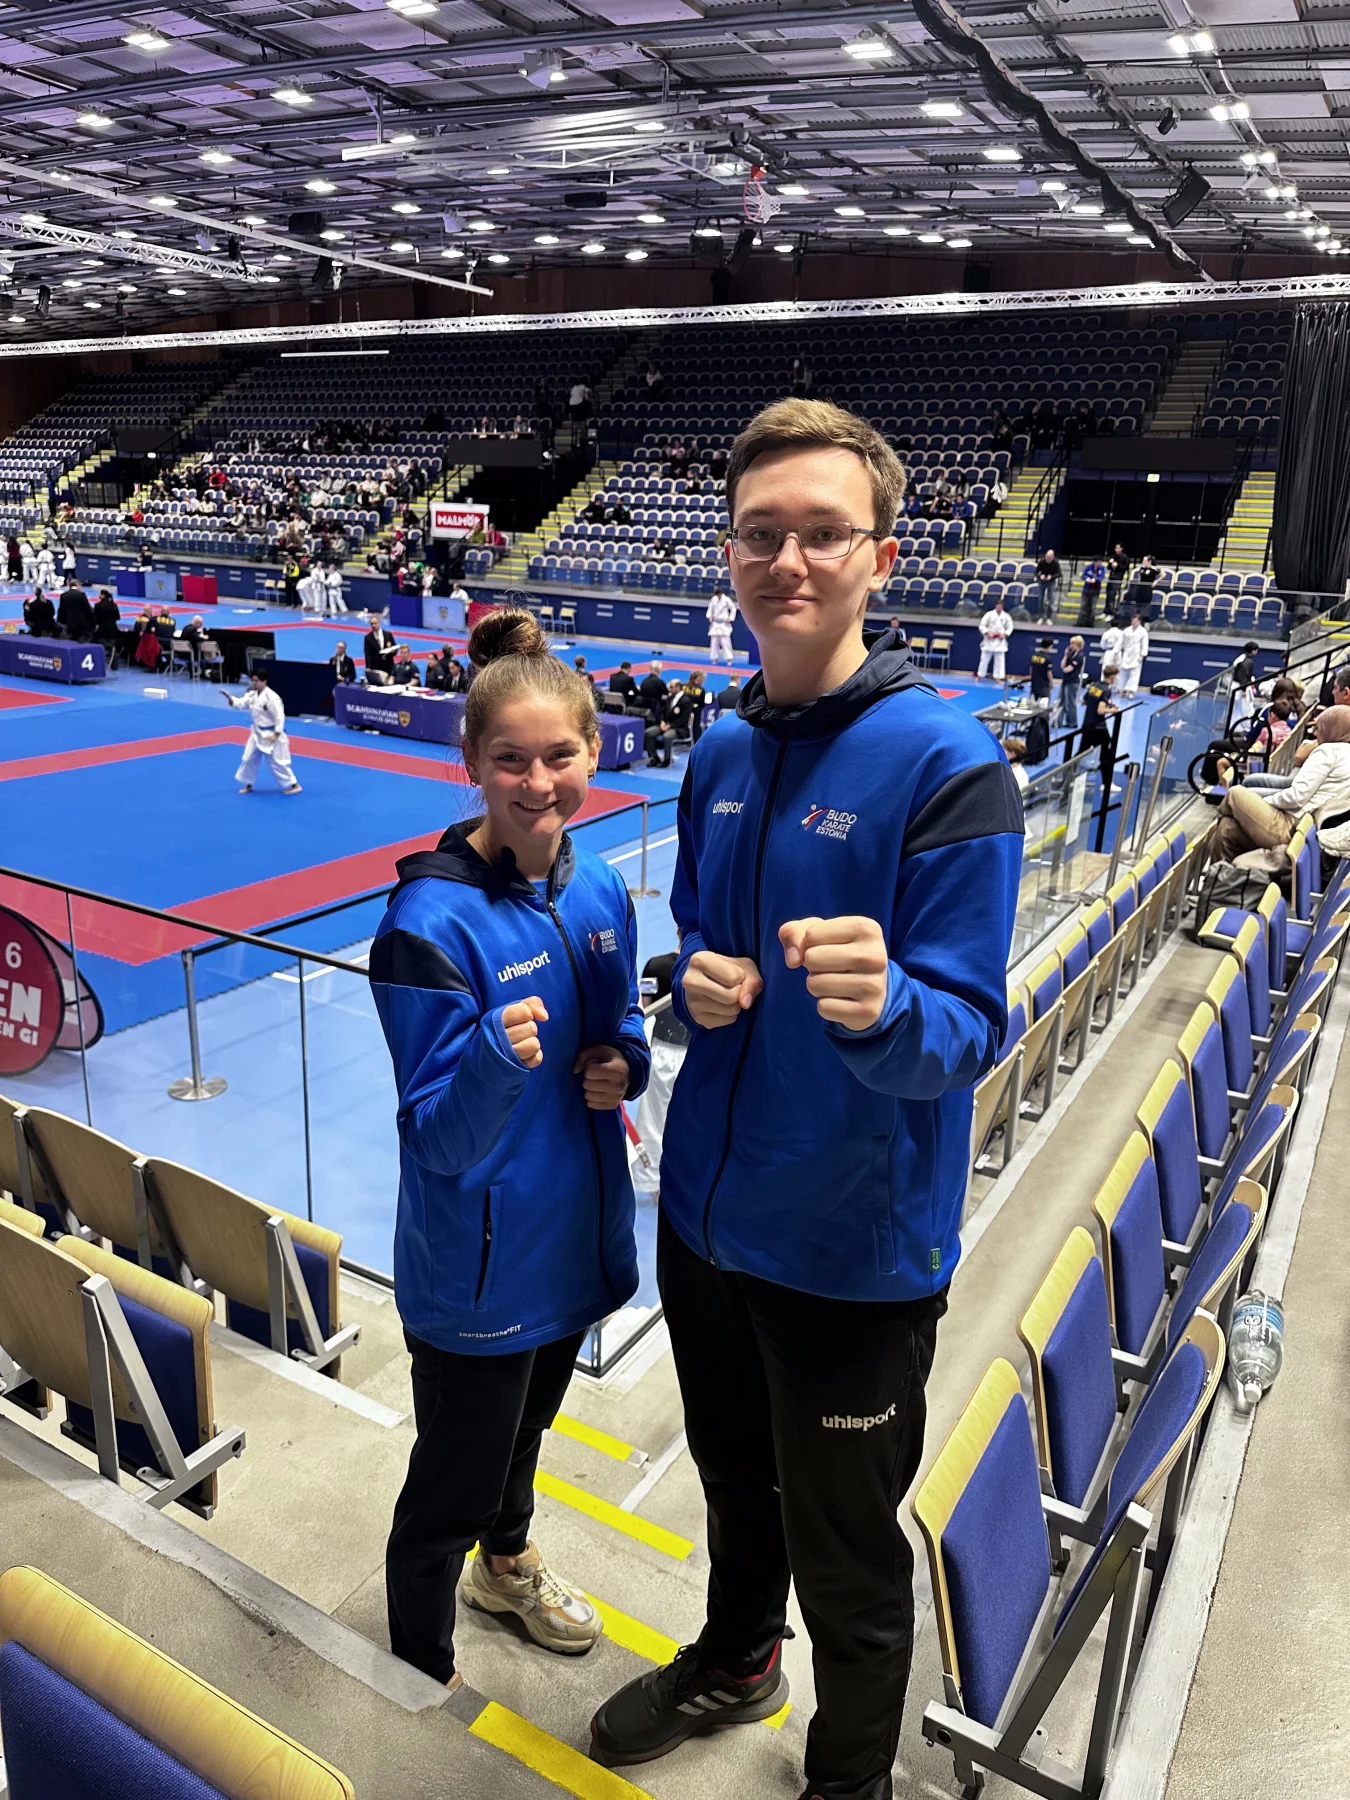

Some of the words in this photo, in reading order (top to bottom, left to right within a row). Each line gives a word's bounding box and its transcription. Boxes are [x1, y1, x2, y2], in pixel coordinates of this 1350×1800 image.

[81, 653, 95, 671] 4
[624, 732, 635, 753] 6
[821, 819, 852, 833] KARATE
[826, 809, 858, 825] BUDO
[815, 825, 848, 841] ESTONIA
[5, 941, 22, 969] 6
[497, 950, 551, 983] uhlsport
[19, 1027, 39, 1047] GI
[822, 1402, 897, 1432] uhlsport
